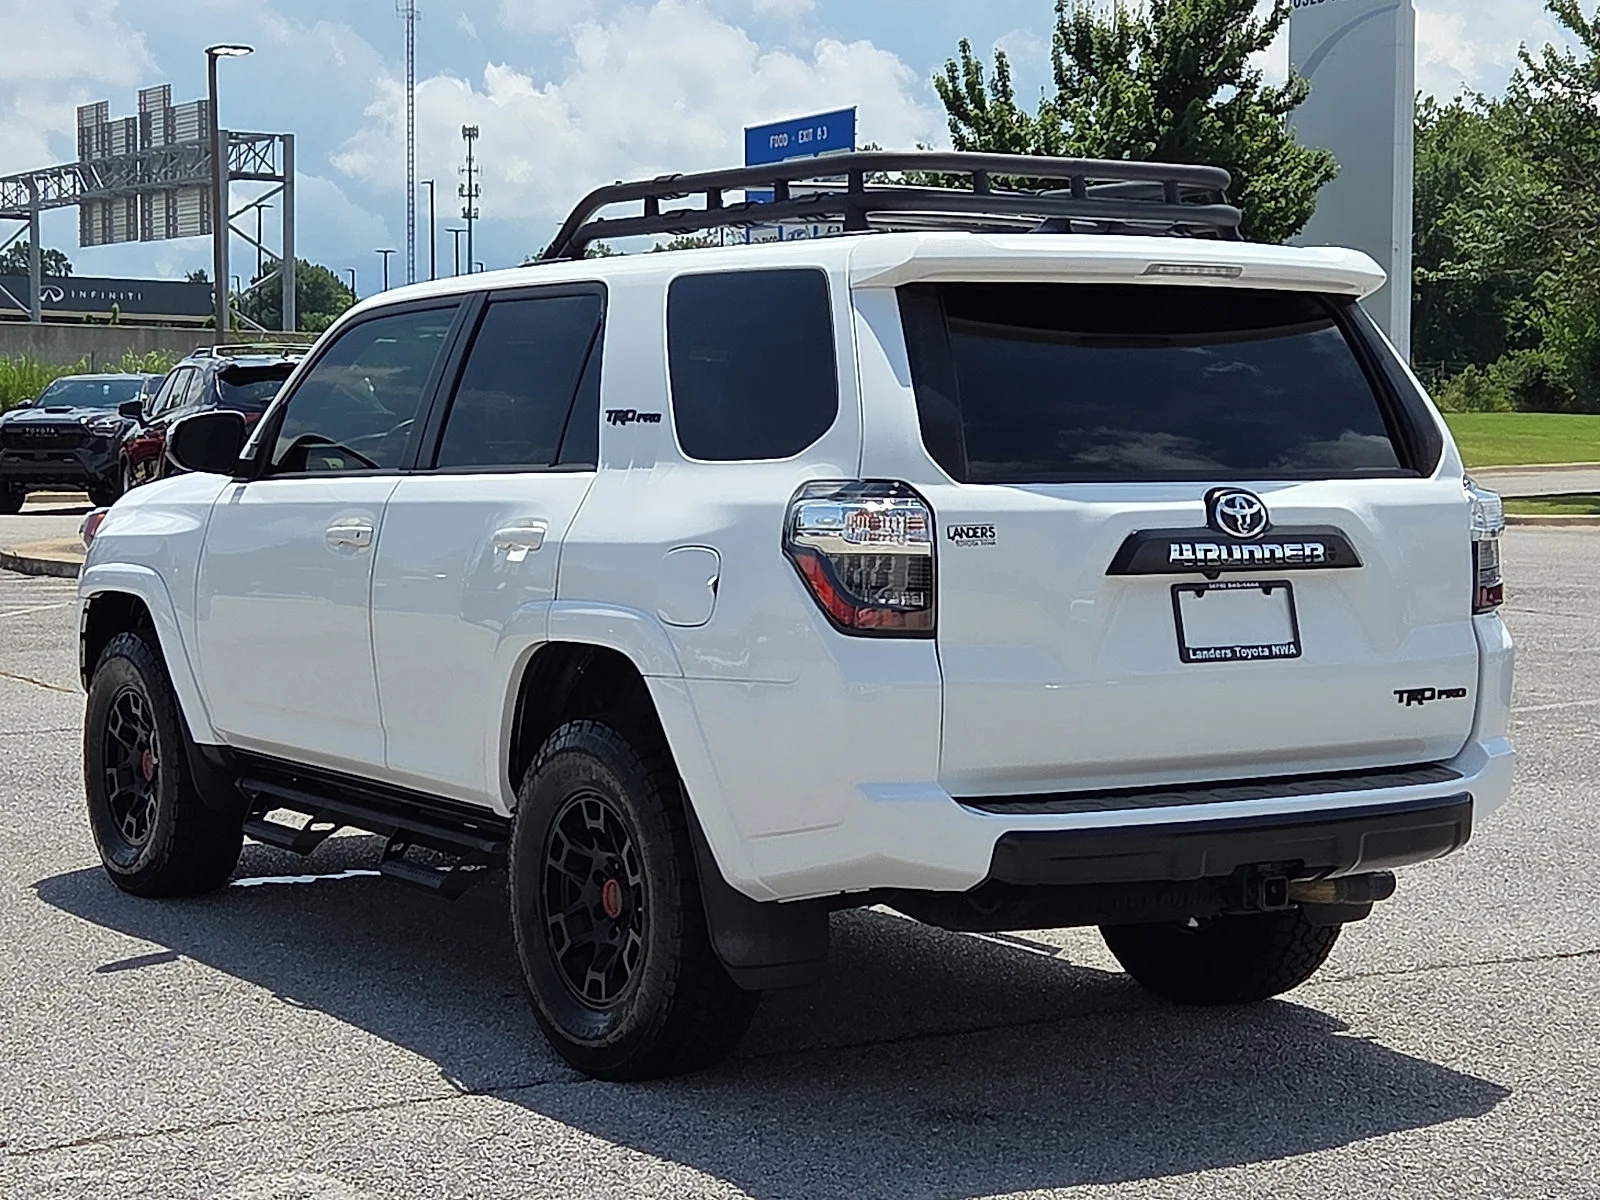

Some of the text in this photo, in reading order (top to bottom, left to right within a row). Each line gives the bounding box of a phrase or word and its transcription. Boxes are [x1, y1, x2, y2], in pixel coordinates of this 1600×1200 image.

[1293, 0, 1325, 9] US
[769, 133, 789, 149] FOOD
[798, 128, 813, 144] EXIT
[71, 289, 142, 301] INFINITI
[605, 409, 637, 426] TRD
[25, 427, 55, 435] TOYOTA
[946, 523, 996, 541] LANDERS
[1169, 543, 1326, 566] 4RUNNER
[1189, 644, 1297, 660] Landers Toyota NWA
[1393, 687, 1467, 707] TRD PRO
